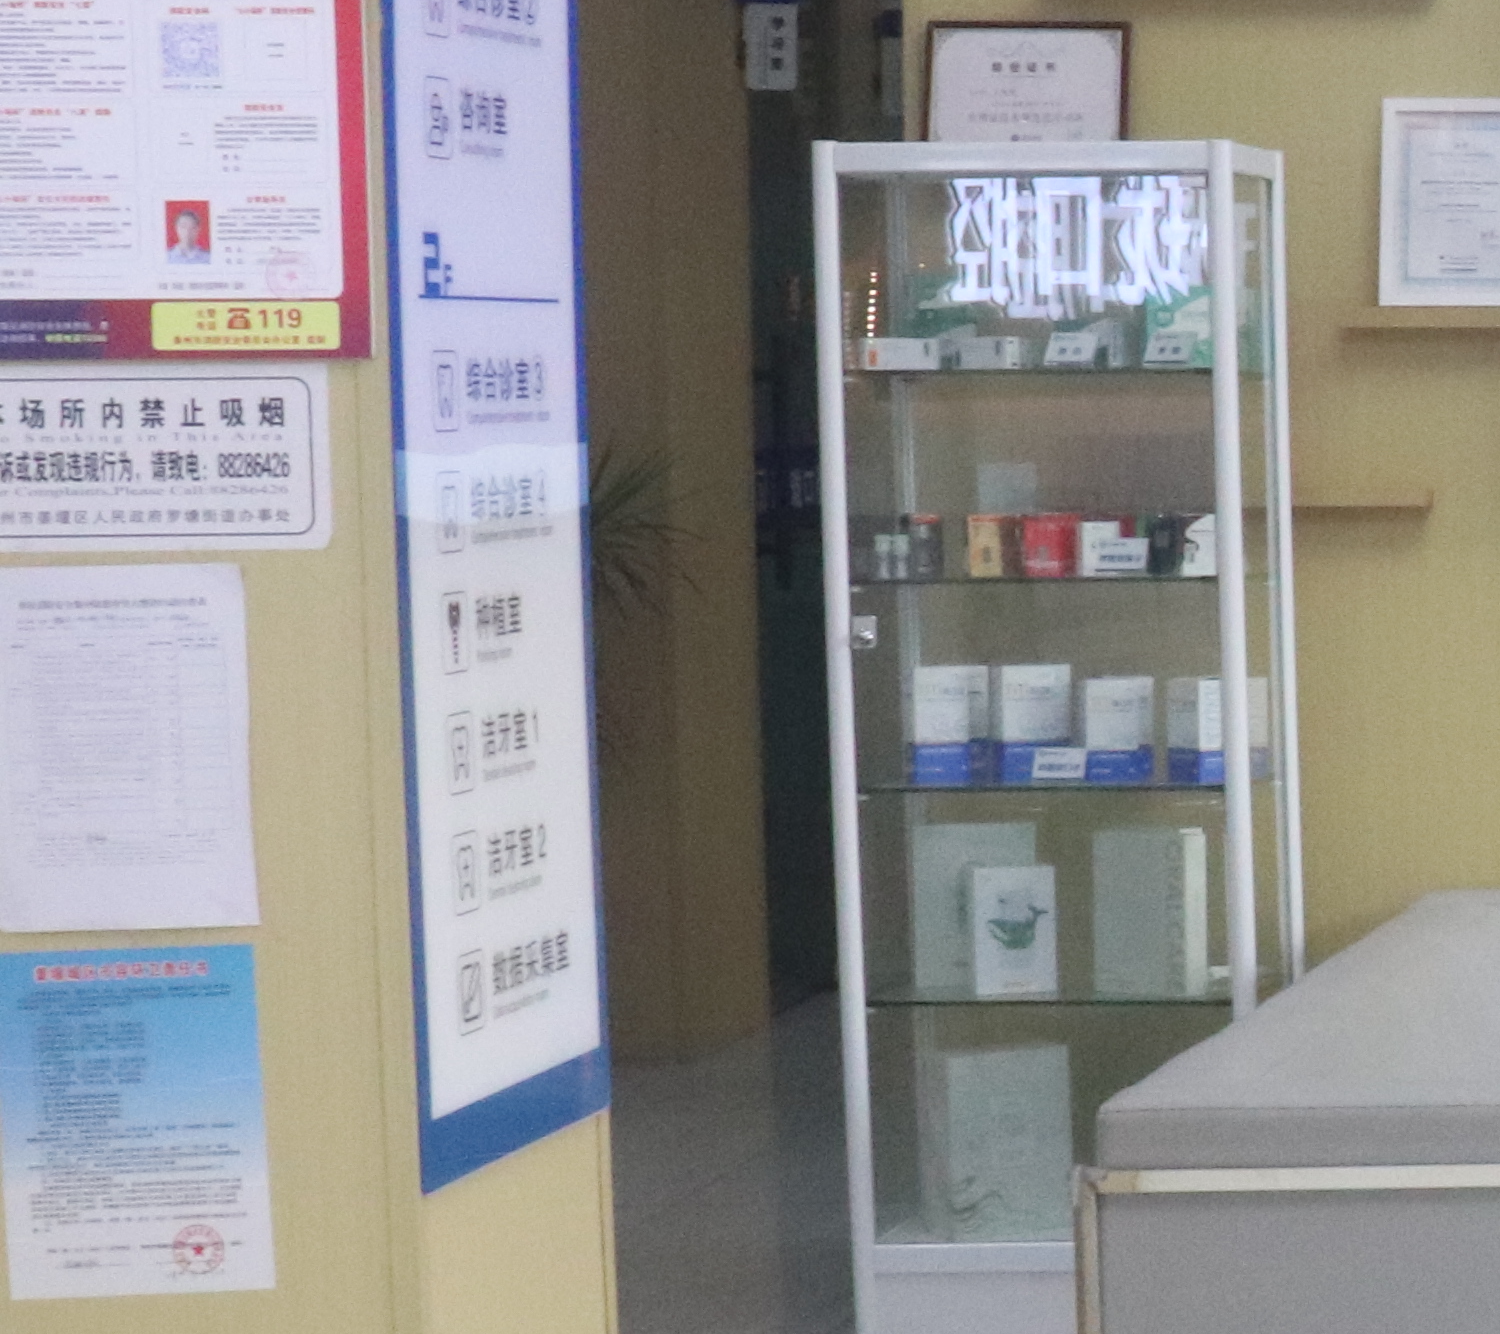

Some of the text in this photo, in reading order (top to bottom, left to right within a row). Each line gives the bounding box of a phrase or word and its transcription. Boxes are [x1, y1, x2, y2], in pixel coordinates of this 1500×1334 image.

[422, 232, 453, 297] 2F
[258, 307, 302, 328] 119
[0, 397, 286, 429] 场所内禁止吸烟
[25, 433, 122, 445] Smoking
[172, 432, 219, 443] This
[232, 433, 283, 442] Area
